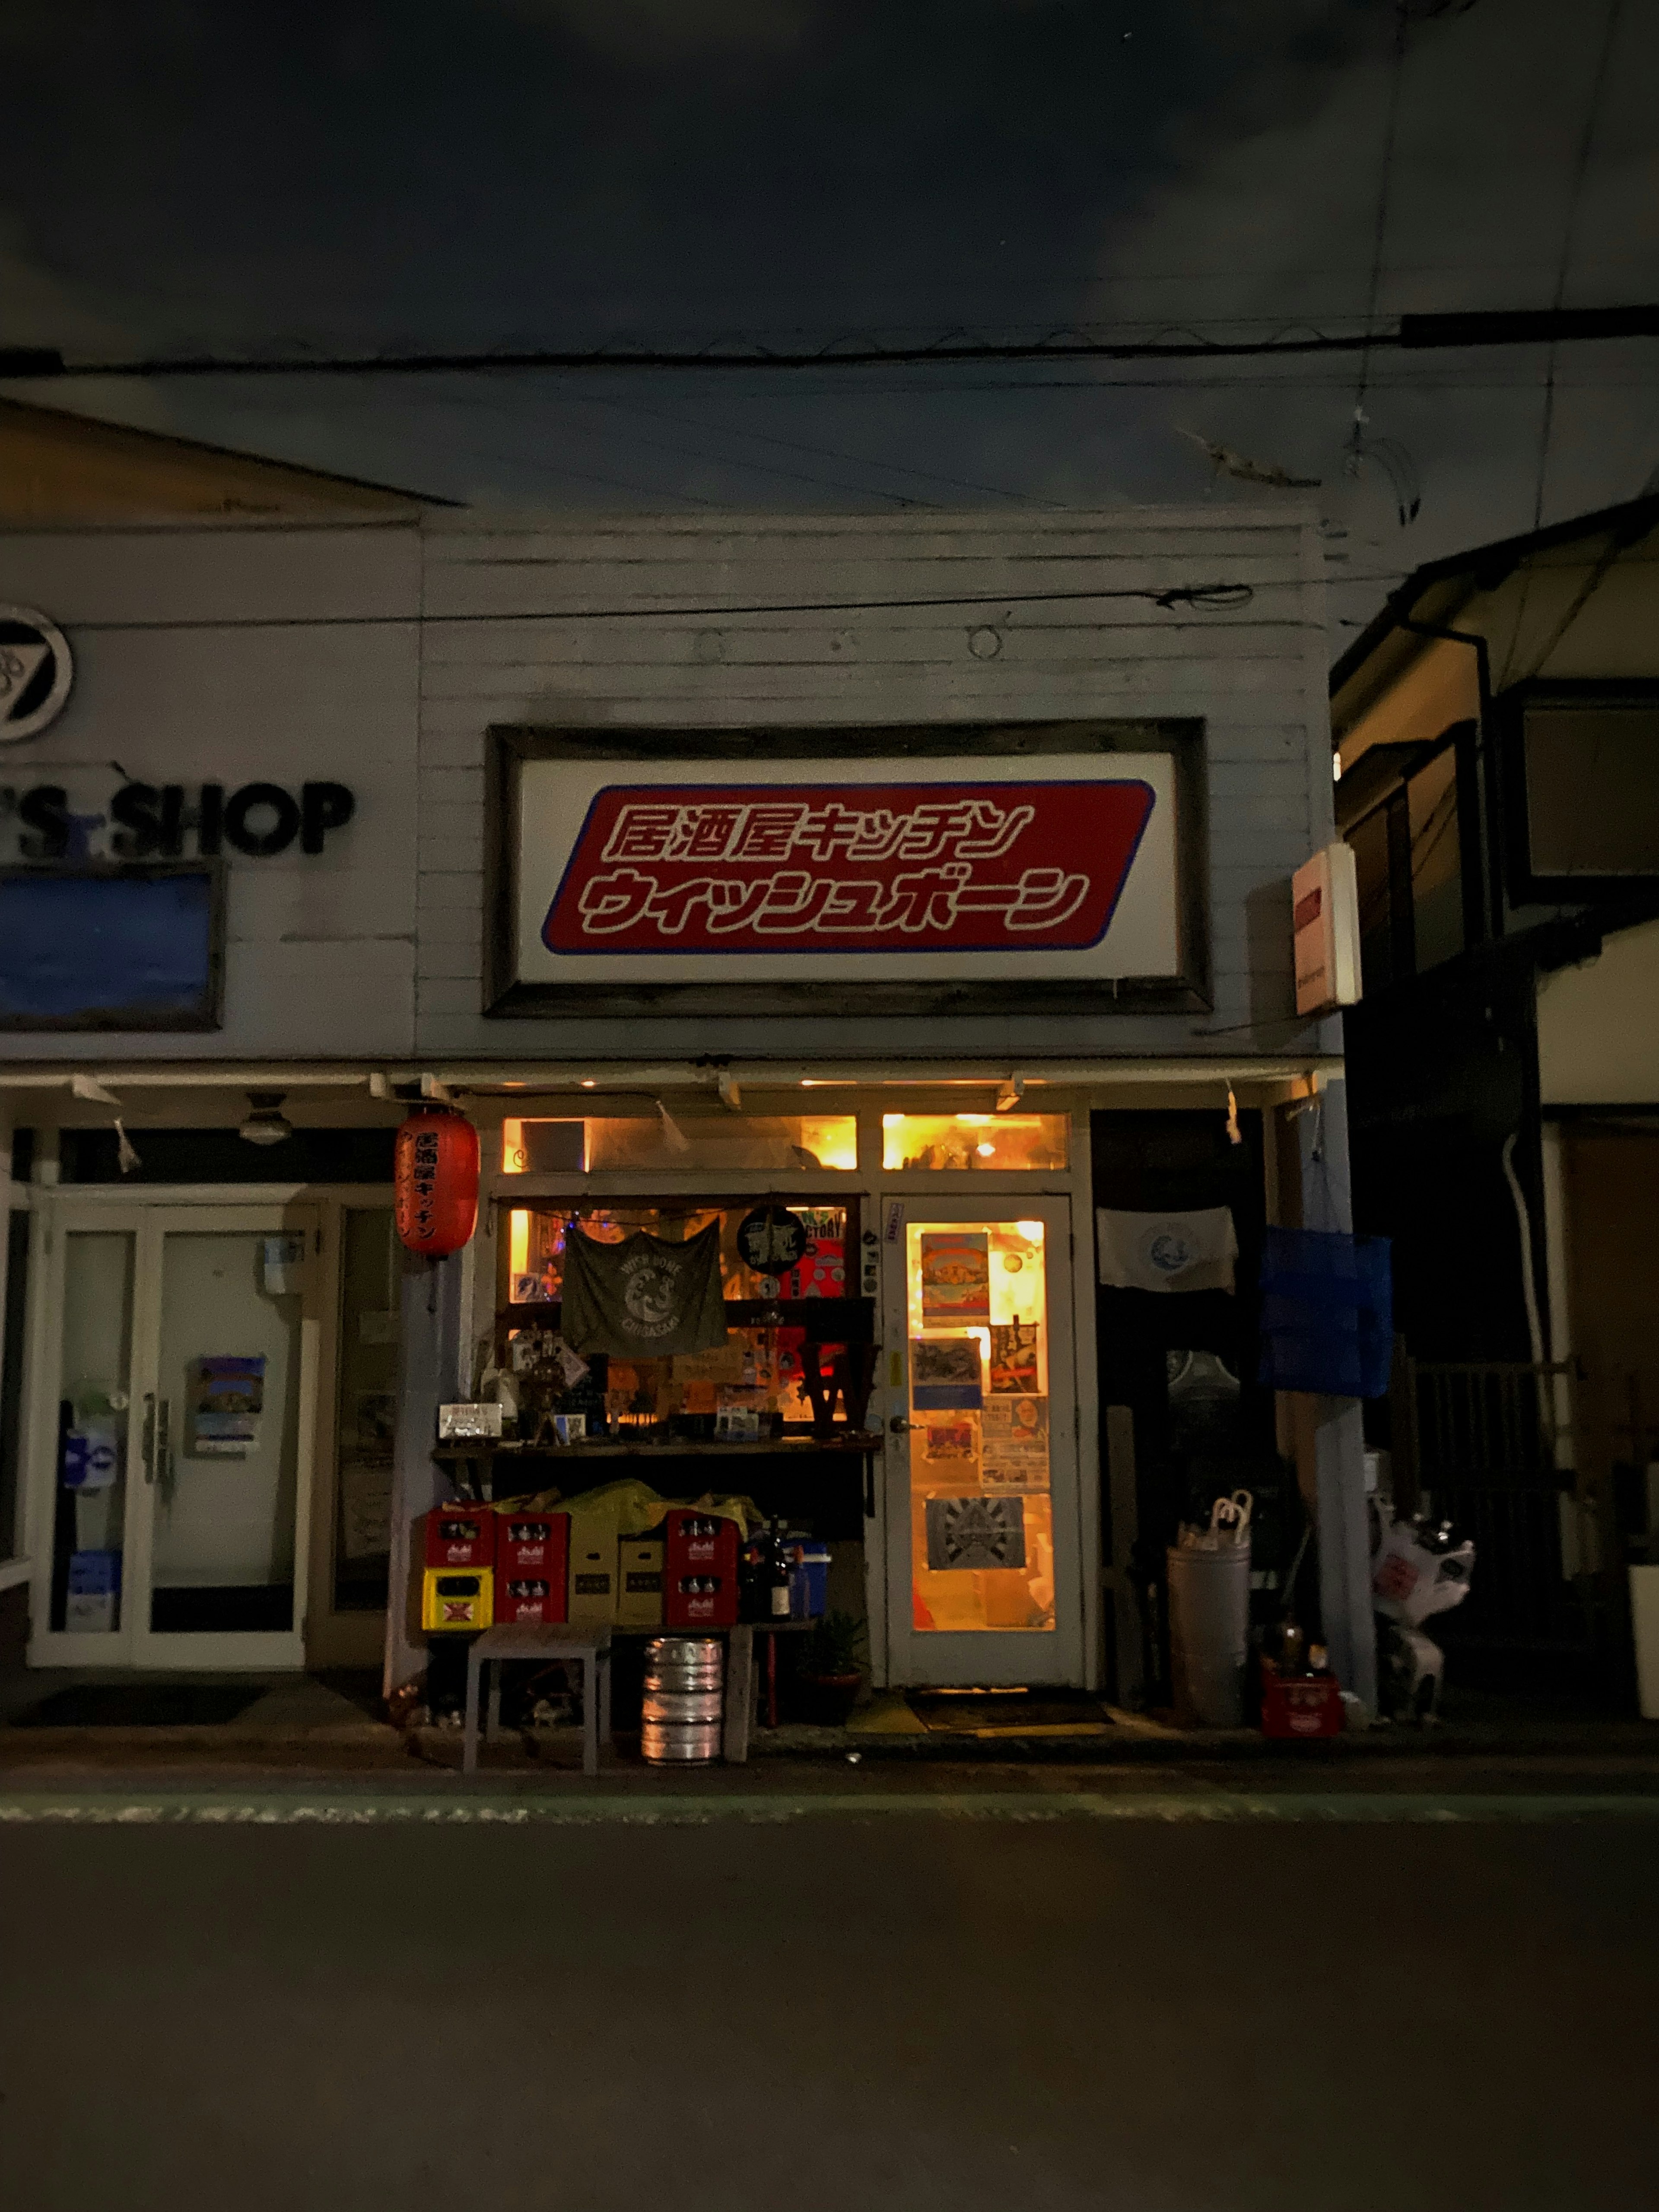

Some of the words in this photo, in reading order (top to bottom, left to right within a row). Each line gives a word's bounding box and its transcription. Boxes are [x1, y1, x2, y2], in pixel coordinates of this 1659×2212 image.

[111, 781, 355, 857] SHOP
[601, 801, 1035, 862] 居酒屋キッチン
[577, 863, 1089, 934] ウィッシュボーン
[413, 1131, 439, 1239] 居酒屋キッチン
